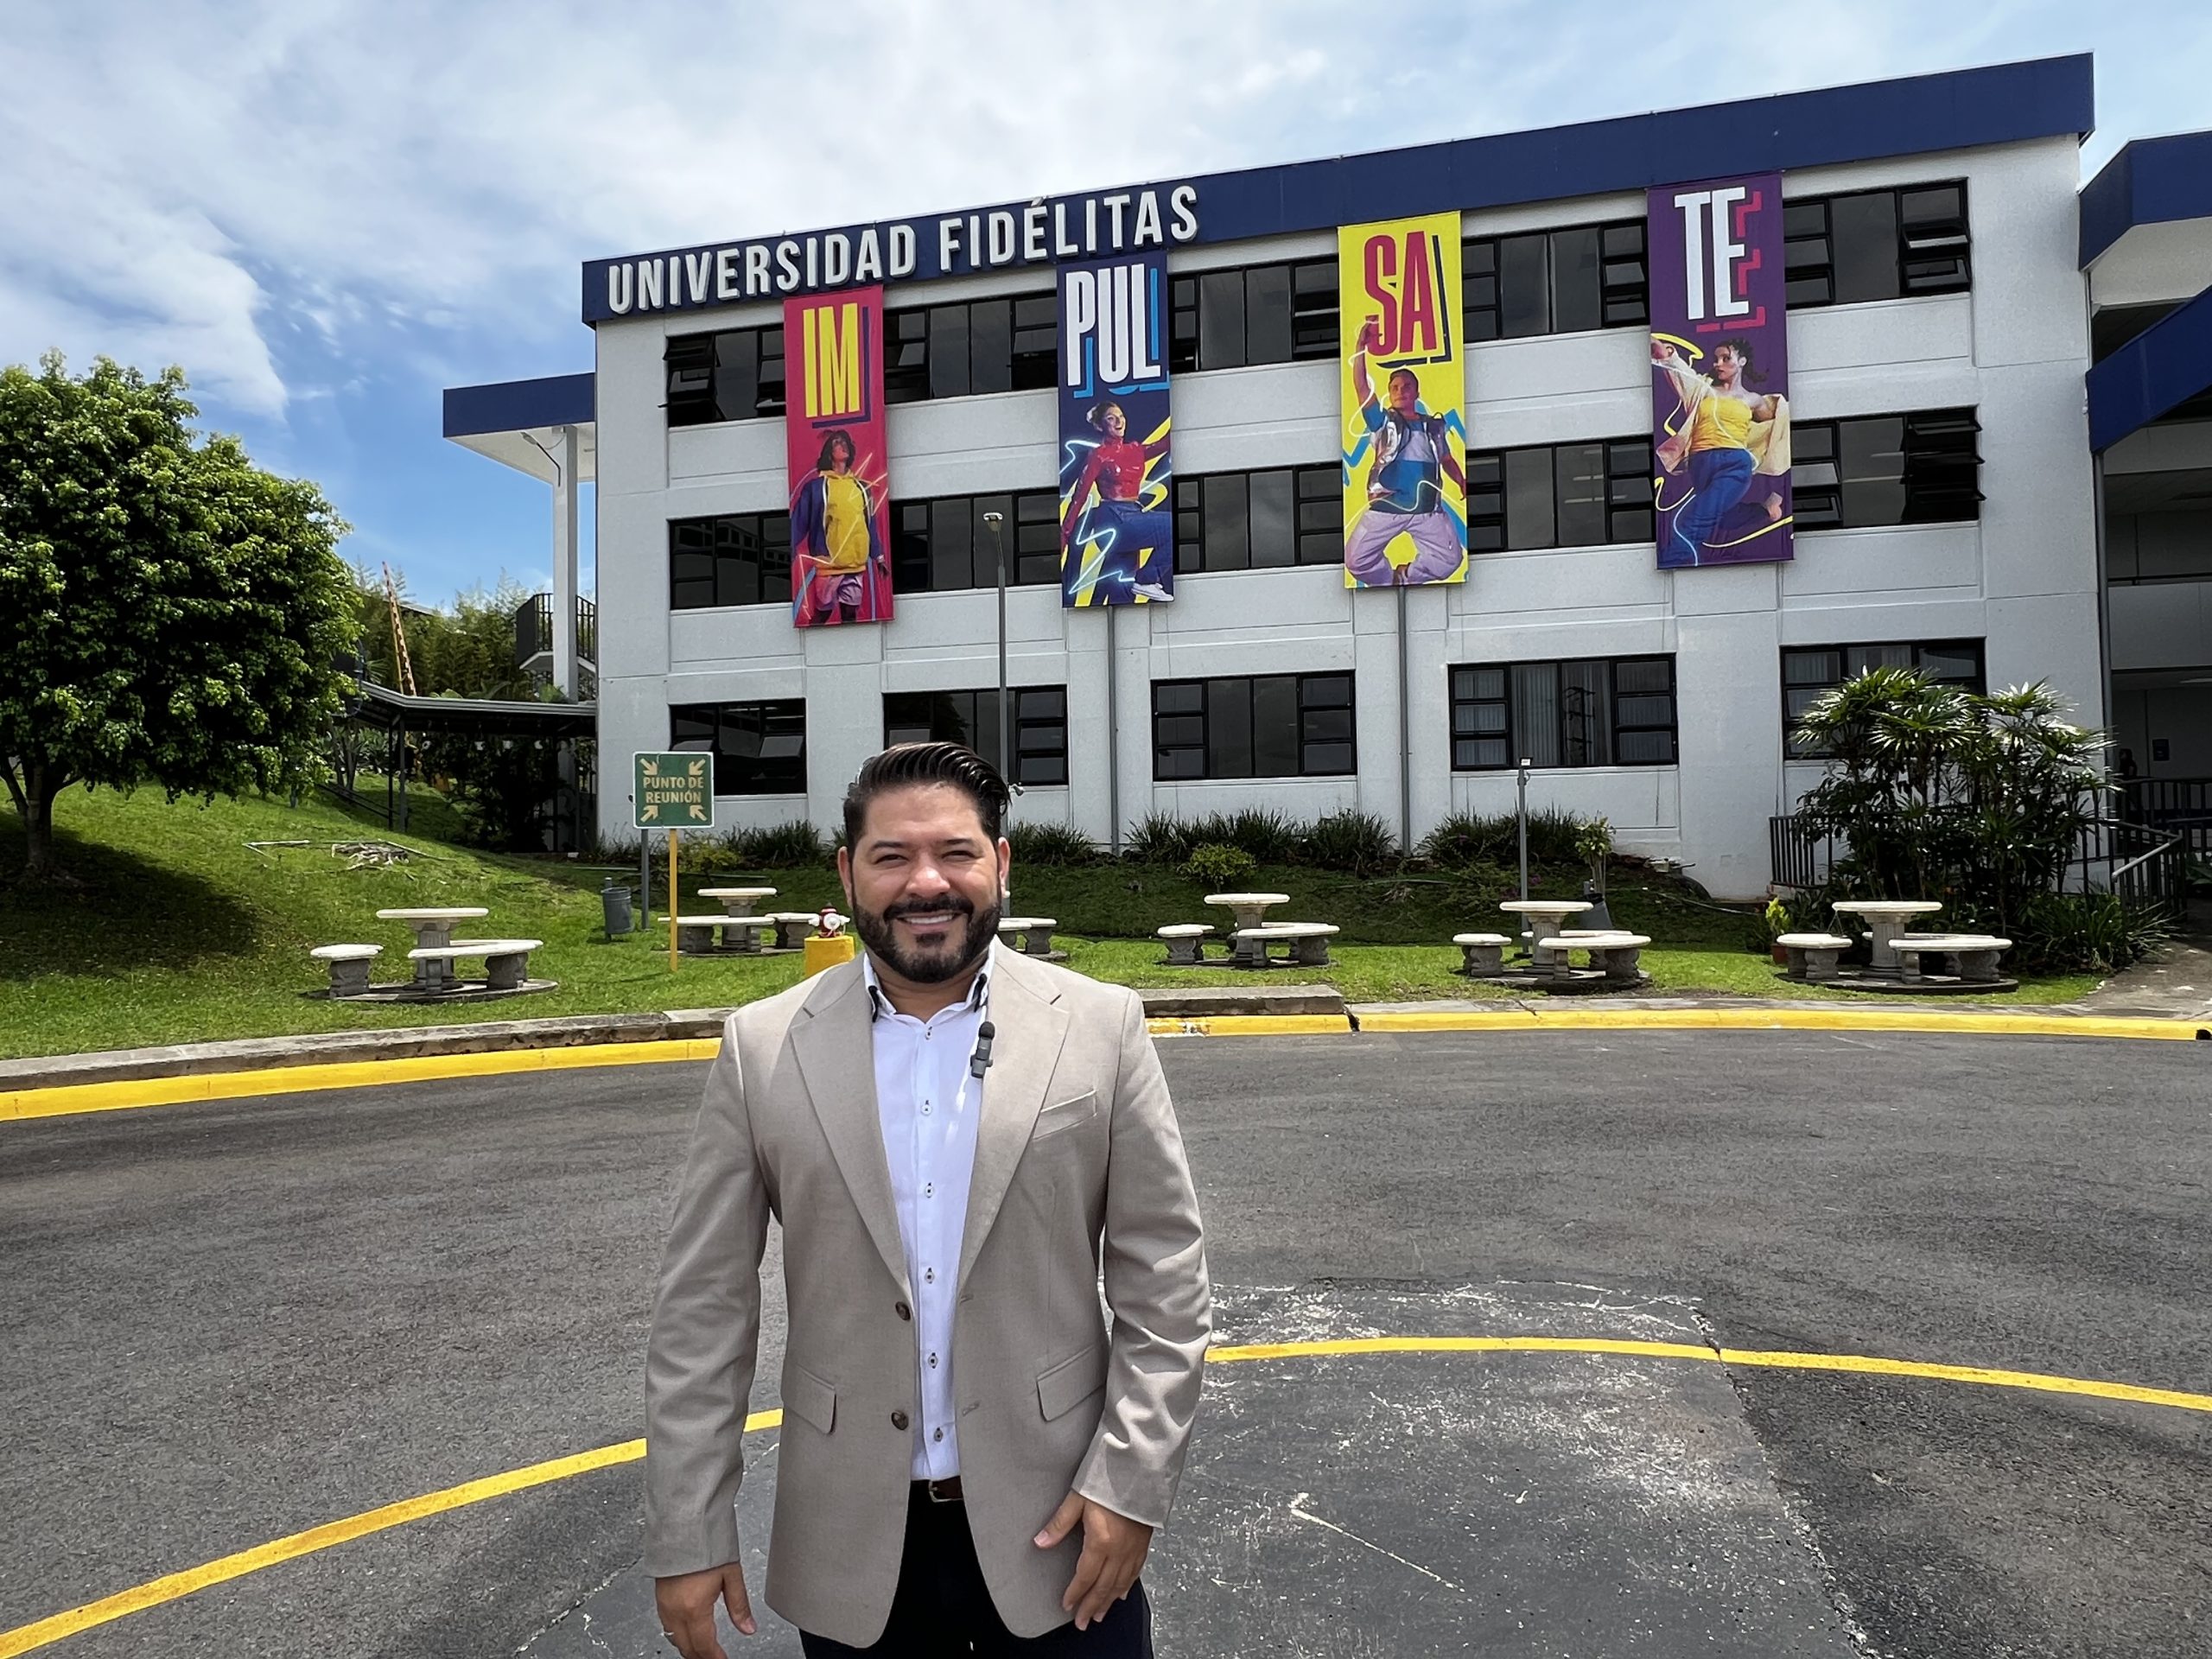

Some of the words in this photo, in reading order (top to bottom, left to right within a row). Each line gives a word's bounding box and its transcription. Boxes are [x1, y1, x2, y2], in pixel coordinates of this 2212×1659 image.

[607, 225, 917, 315] UNIVERSIDAD
[939, 185, 1199, 273] FIDÉLITAS
[1363, 230, 1437, 357] SA
[1674, 186, 1750, 321] TE
[803, 302, 861, 417] IM
[1065, 263, 1163, 386] PUL
[643, 777, 686, 789] PUNTO
[688, 777, 704, 789] DE
[645, 790, 702, 804] REUNIÓN
